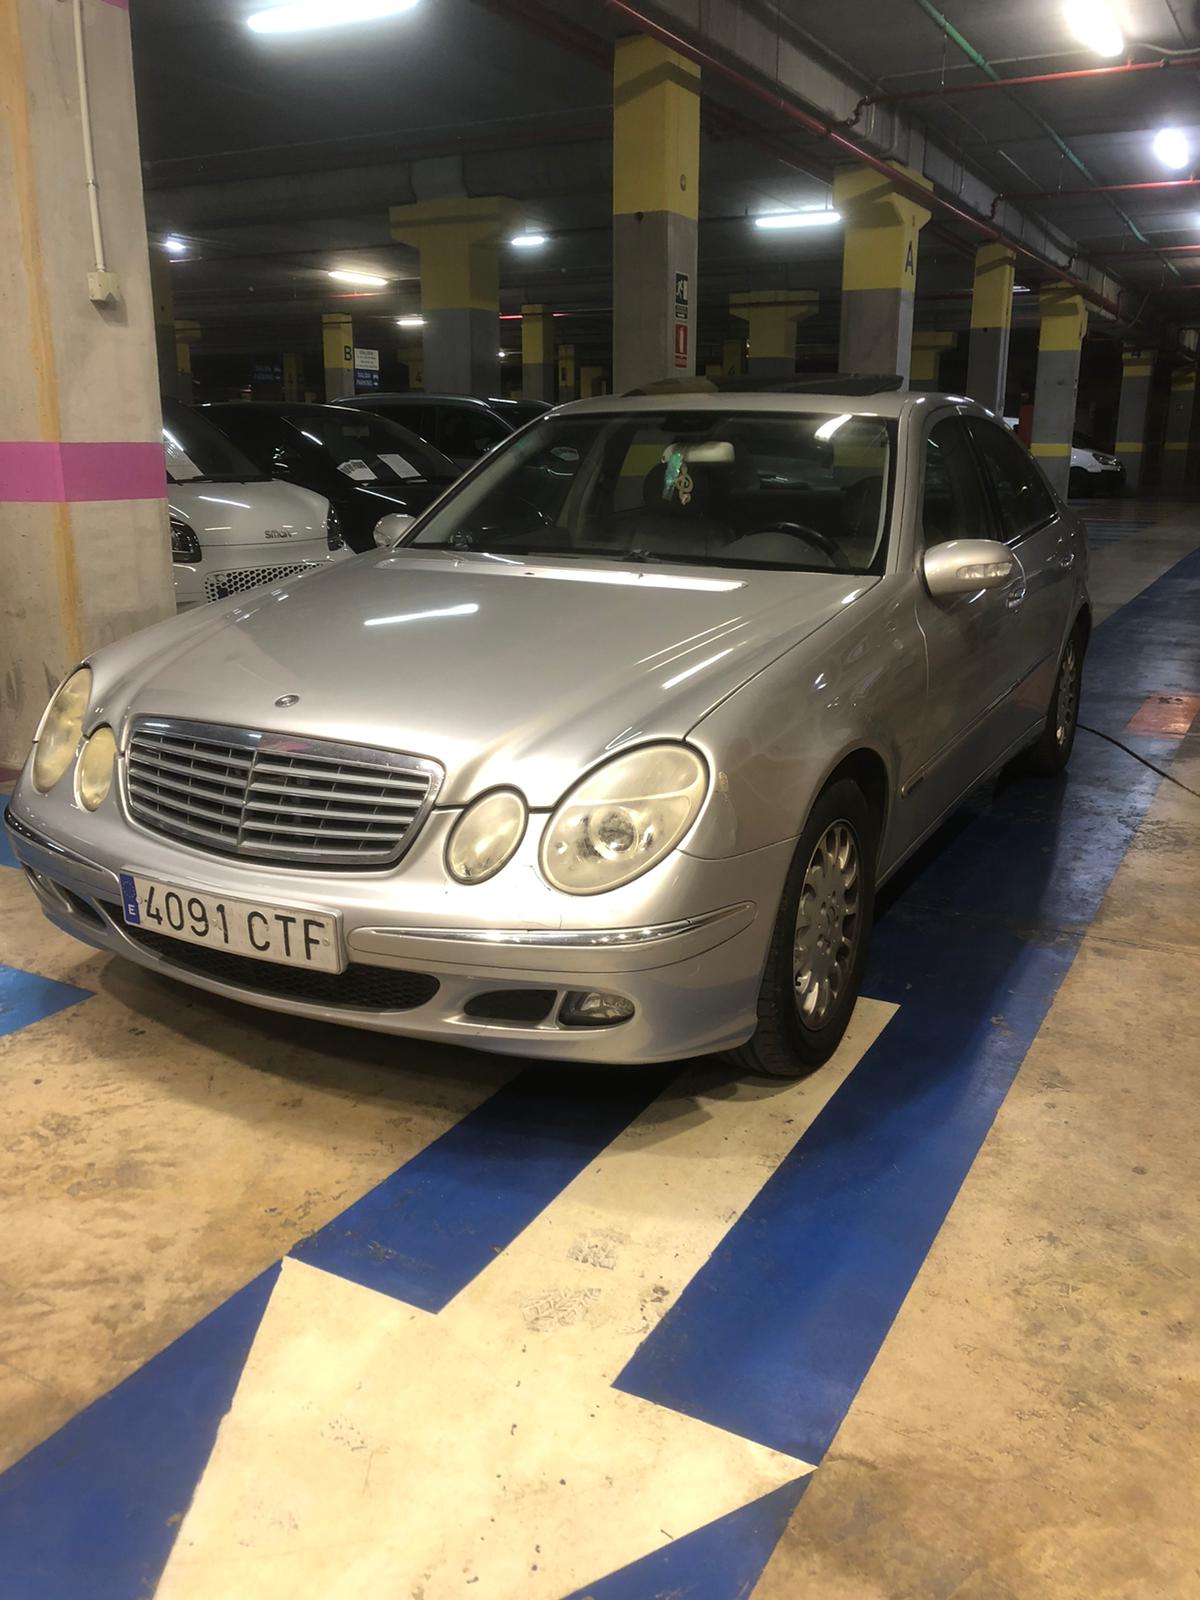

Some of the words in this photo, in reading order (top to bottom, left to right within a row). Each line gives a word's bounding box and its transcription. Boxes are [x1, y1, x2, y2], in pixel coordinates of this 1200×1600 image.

[904, 240, 915, 276] A
[343, 345, 352, 361] B
[264, 529, 295, 539] smar
[127, 903, 136, 916] E
[144, 886, 229, 944] 4091
[247, 911, 326, 961] CTF
